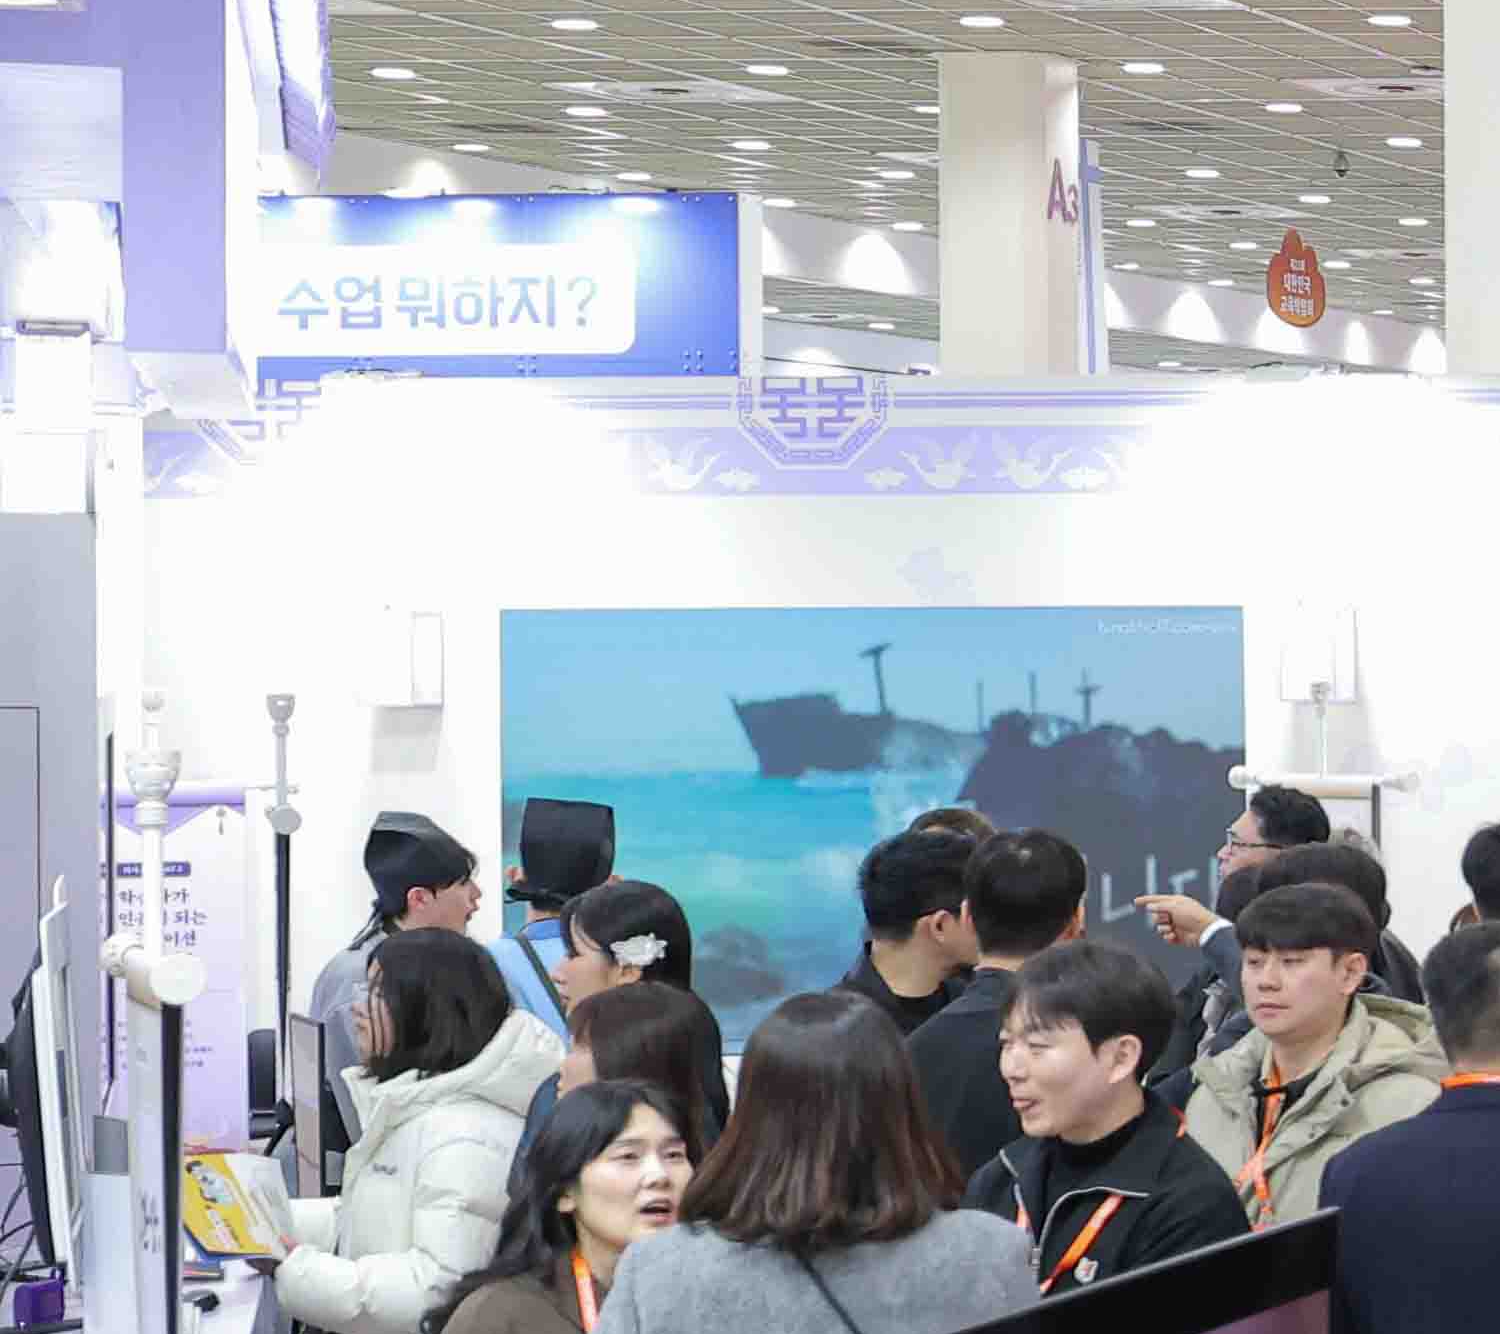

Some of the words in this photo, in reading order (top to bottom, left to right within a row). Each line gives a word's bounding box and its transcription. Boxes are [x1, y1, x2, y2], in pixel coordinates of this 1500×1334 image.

[1046, 157, 1079, 223] A3
[277, 275, 386, 332] 수업
[395, 275, 598, 331] 뭐하지?
